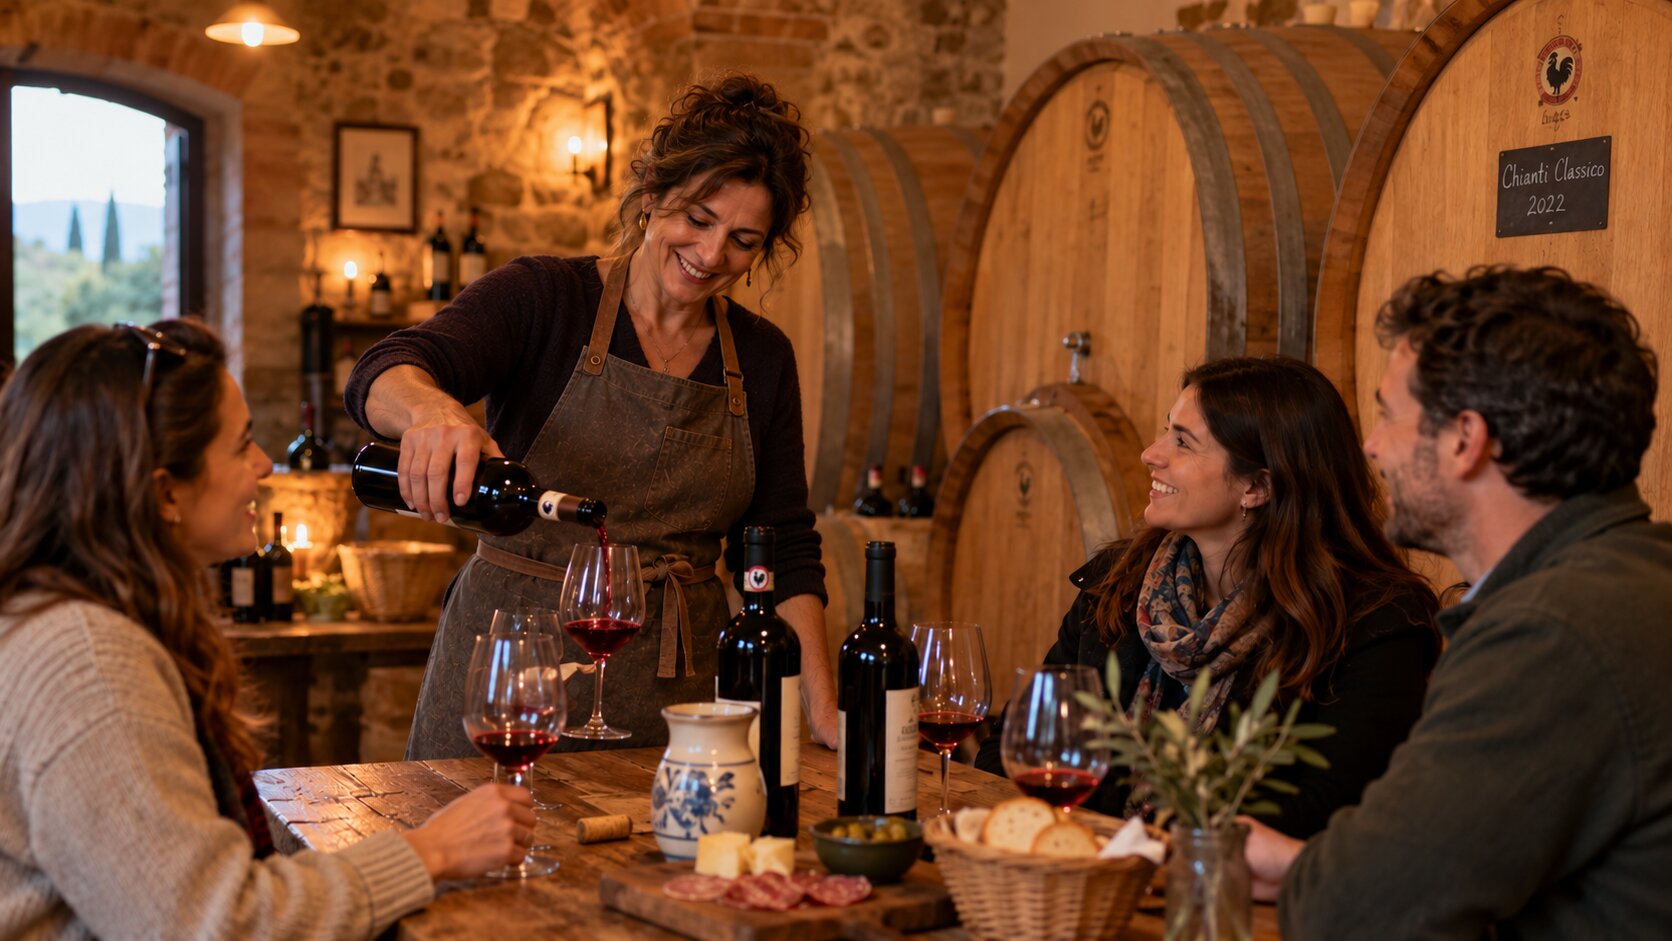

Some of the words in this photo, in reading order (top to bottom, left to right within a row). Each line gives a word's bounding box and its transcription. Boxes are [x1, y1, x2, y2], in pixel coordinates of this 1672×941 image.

[1502, 163, 1549, 188] Chianti
[1555, 157, 1605, 181] Classico
[1527, 194, 1566, 216] 2022
